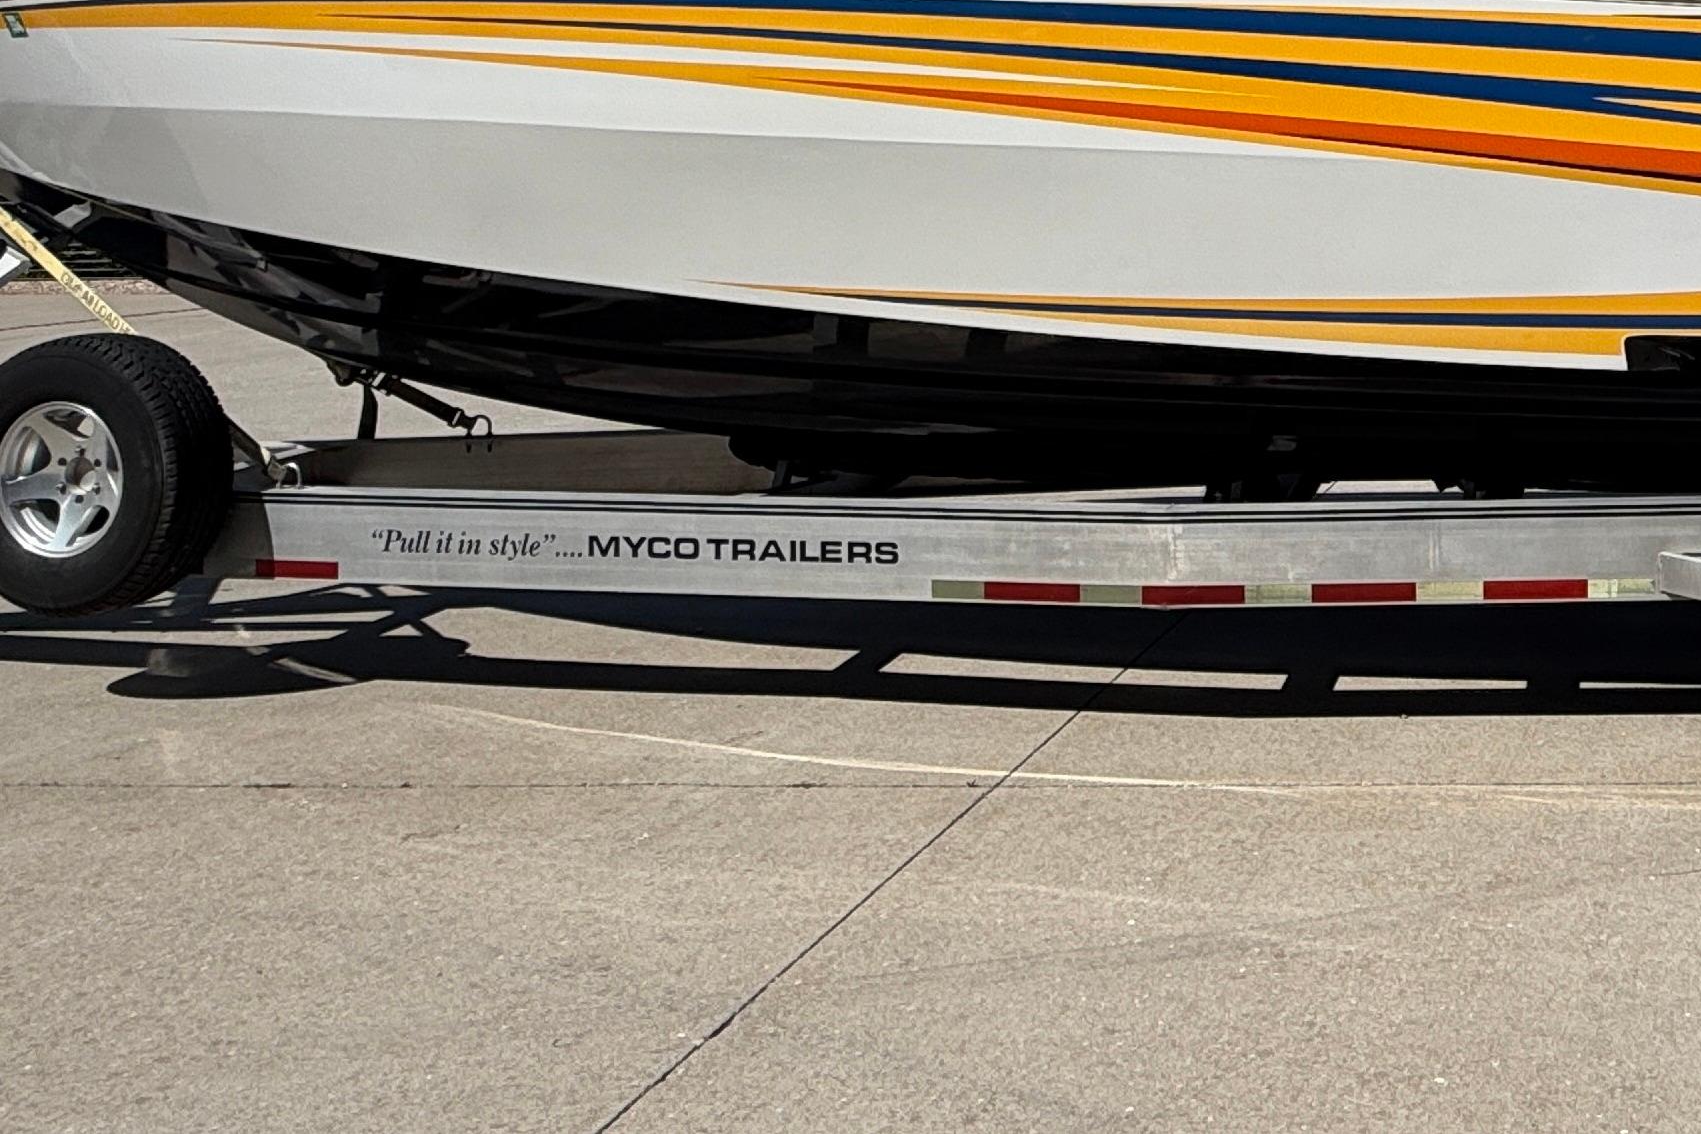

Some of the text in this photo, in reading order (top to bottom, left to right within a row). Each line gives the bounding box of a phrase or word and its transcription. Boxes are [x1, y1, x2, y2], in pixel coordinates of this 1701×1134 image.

[436, 530, 453, 554] it
[458, 531, 481, 555] in
[588, 535, 699, 559] MYCO
[706, 538, 899, 564] TRAILERS
